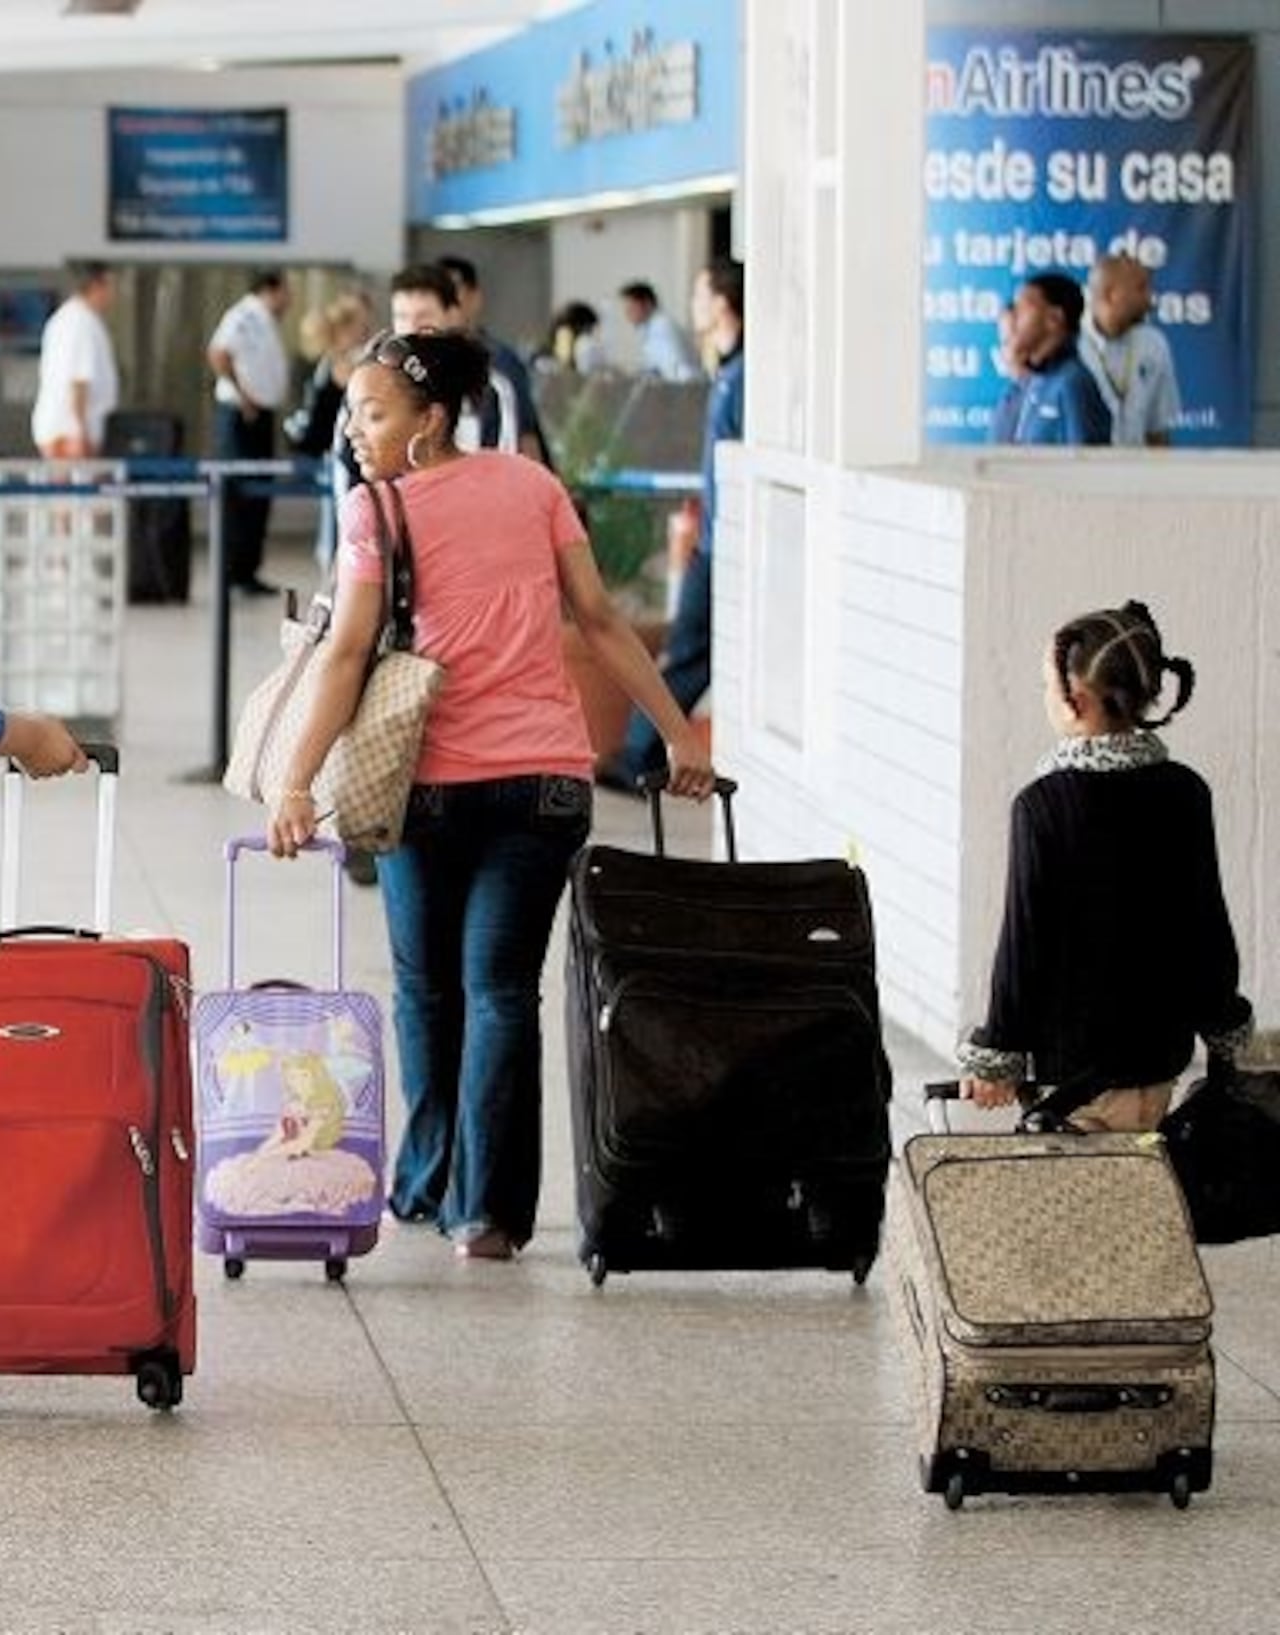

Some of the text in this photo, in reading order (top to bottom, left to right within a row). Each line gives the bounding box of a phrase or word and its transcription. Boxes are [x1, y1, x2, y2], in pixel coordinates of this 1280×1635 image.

[1046, 150, 1107, 201] su
[1121, 151, 1234, 203] casa
[953, 229, 1097, 274] tarjeta
[925, 344, 978, 378] su
